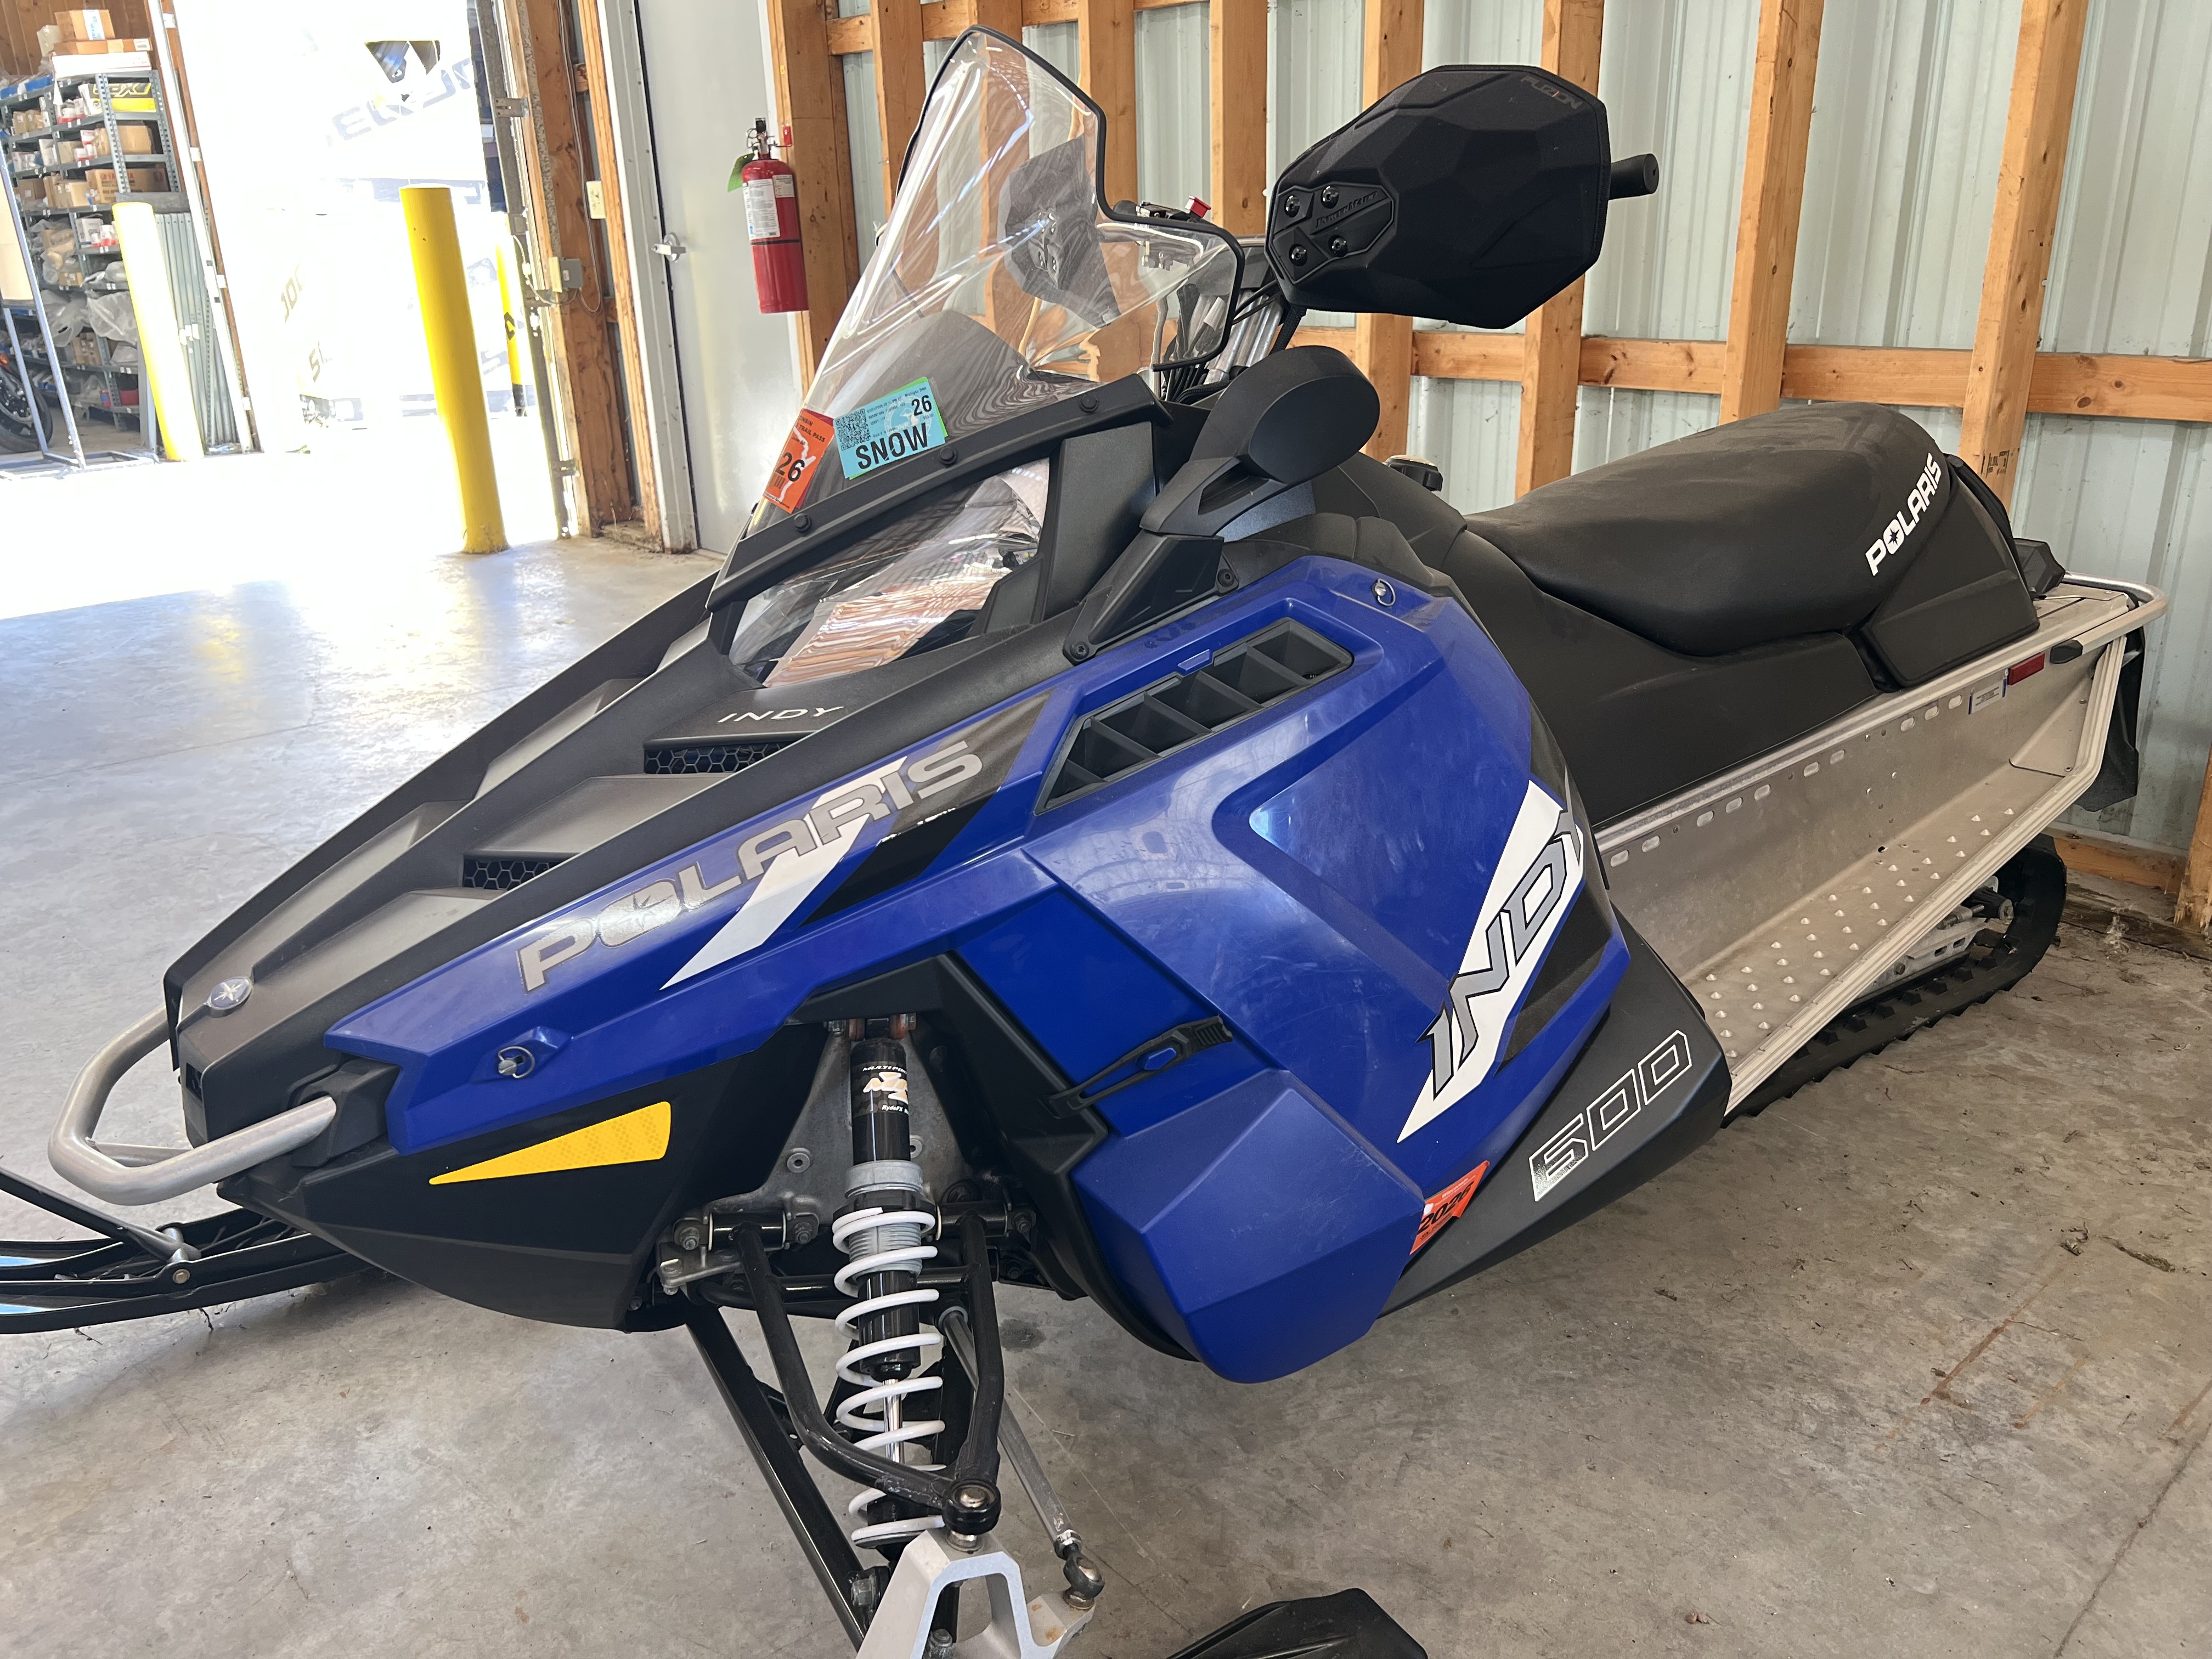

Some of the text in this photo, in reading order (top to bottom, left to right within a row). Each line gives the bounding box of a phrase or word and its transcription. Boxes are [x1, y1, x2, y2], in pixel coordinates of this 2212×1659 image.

[911, 394, 932, 416] 26
[799, 424, 812, 435] TRAIL
[812, 432, 826, 443] PASS
[855, 422, 928, 470] SNOW
[775, 452, 805, 482] 26
[1865, 452, 1942, 577] POLARIS
[716, 706, 845, 723] INDY
[516, 740, 984, 992] POLARIS
[1417, 764, 1581, 1101] INDY
[1528, 1029, 1692, 1202] 500
[1417, 1181, 1474, 1235] 2026
